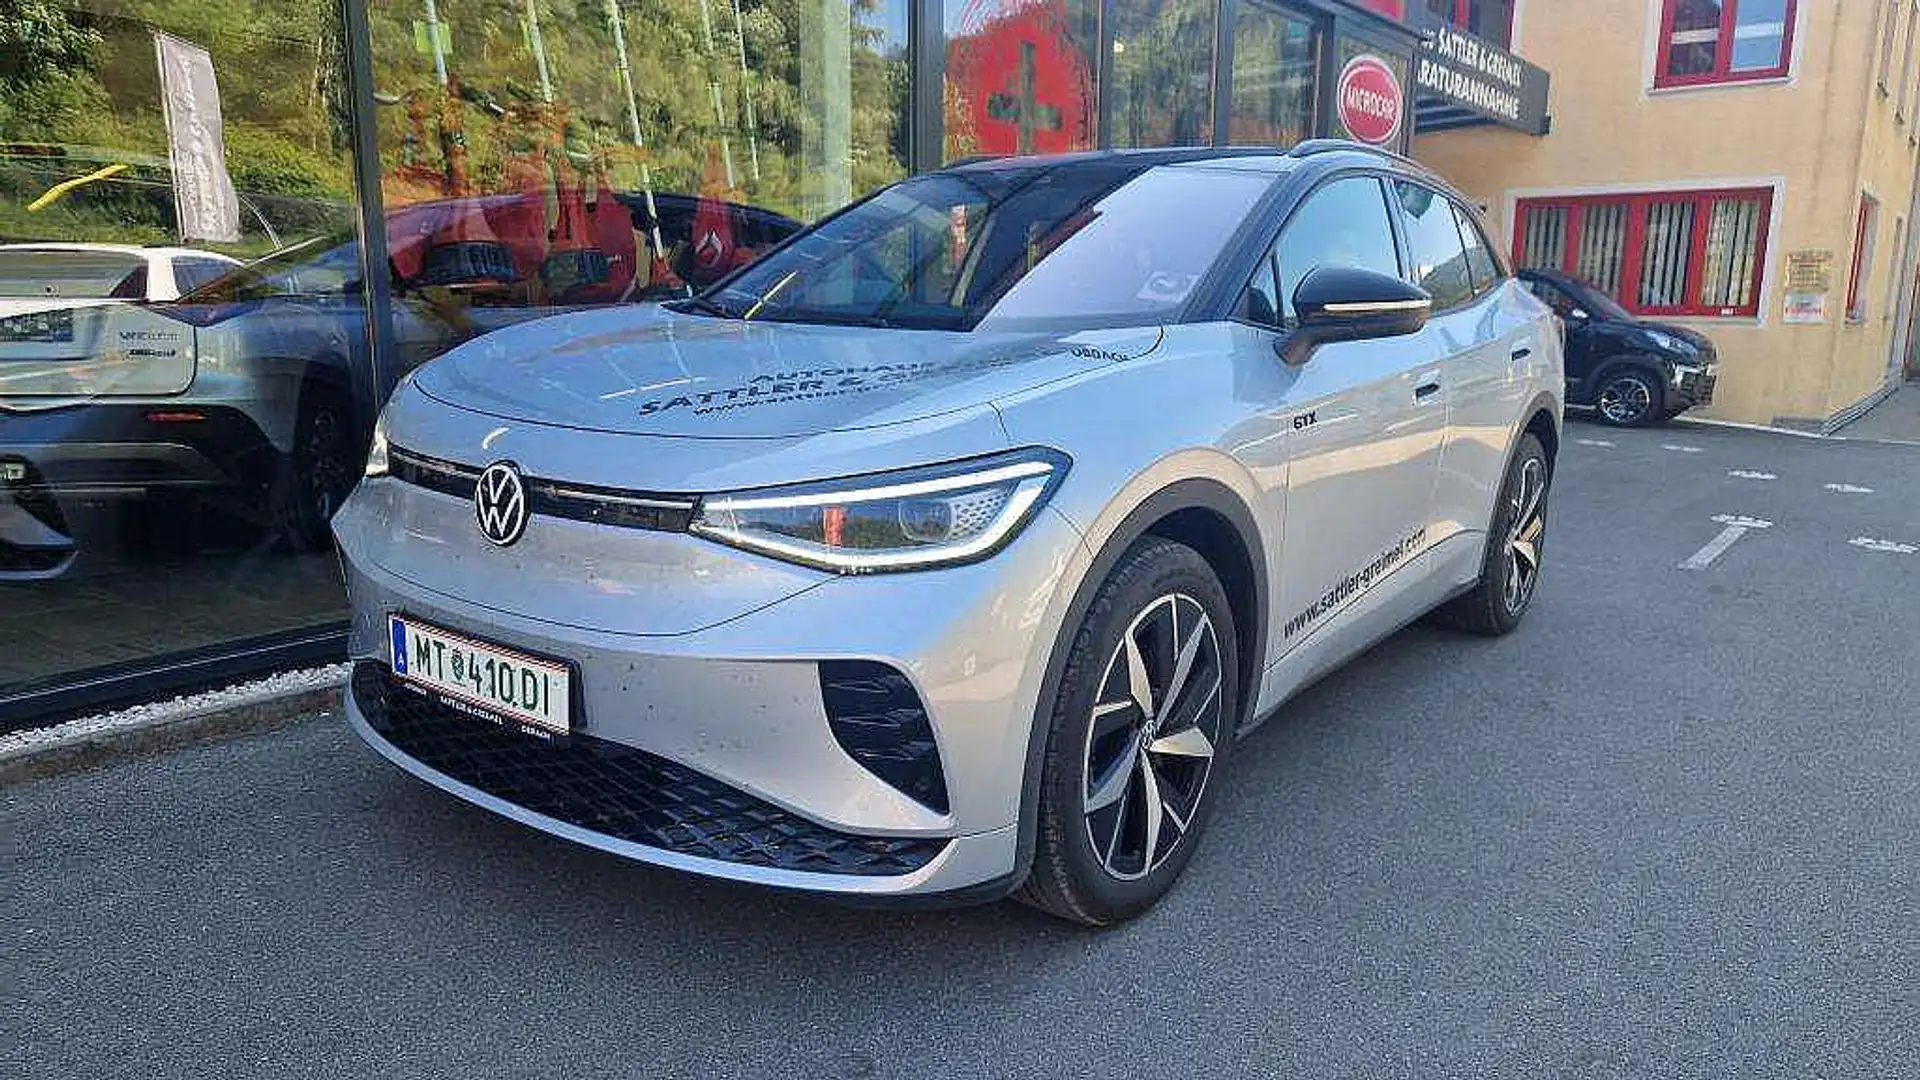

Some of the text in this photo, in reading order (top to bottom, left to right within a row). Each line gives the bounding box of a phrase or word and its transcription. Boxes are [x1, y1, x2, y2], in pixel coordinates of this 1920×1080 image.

[639, 379, 824, 416] SATTLER
[1293, 410, 1319, 430] GTX
[415, 634, 446, 681] MT
